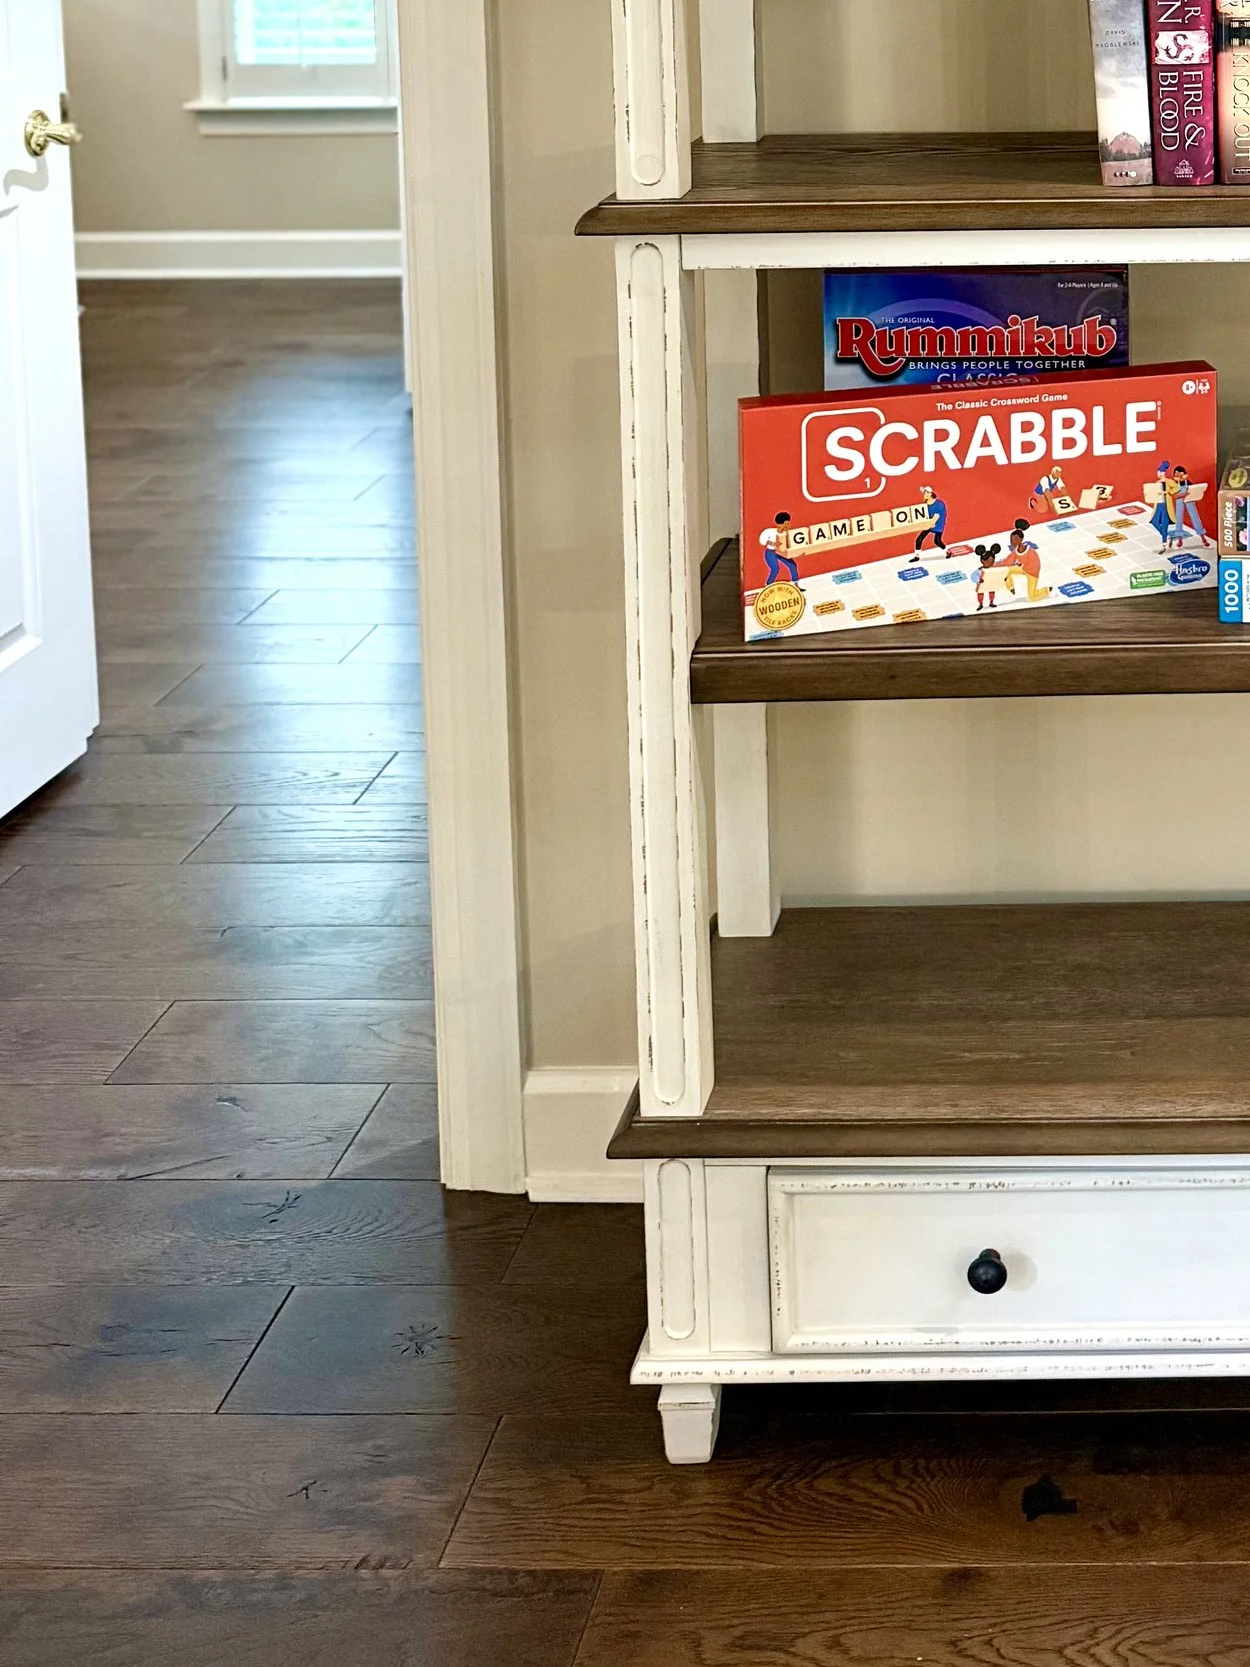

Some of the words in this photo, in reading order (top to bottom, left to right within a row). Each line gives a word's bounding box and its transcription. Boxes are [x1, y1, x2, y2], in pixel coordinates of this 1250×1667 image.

[1184, 6, 1201, 24] R.
[1183, 70, 1204, 119] FIRE
[1158, 71, 1180, 151] BLOOD
[1184, 122, 1206, 151] &
[836, 314, 1117, 376] Rummikub
[909, 361, 957, 370] BRINGS
[963, 360, 1010, 369] PEOPLE
[1016, 360, 1086, 369] TOGETHER
[936, 402, 953, 411] The
[955, 400, 988, 410] Classic
[990, 395, 1039, 407] Crossword
[1041, 393, 1068, 402] Game
[824, 401, 1157, 481] SCRABBLE
[864, 477, 871, 489] 1
[793, 518, 866, 545] GAME
[896, 507, 926, 523] ON
[1224, 501, 1233, 528] Piece
[1223, 529, 1233, 548] 500
[761, 588, 775, 603] NOW
[777, 586, 795, 595] WITH
[1224, 569, 1239, 613] 1000
[758, 597, 800, 616] WOODEN
